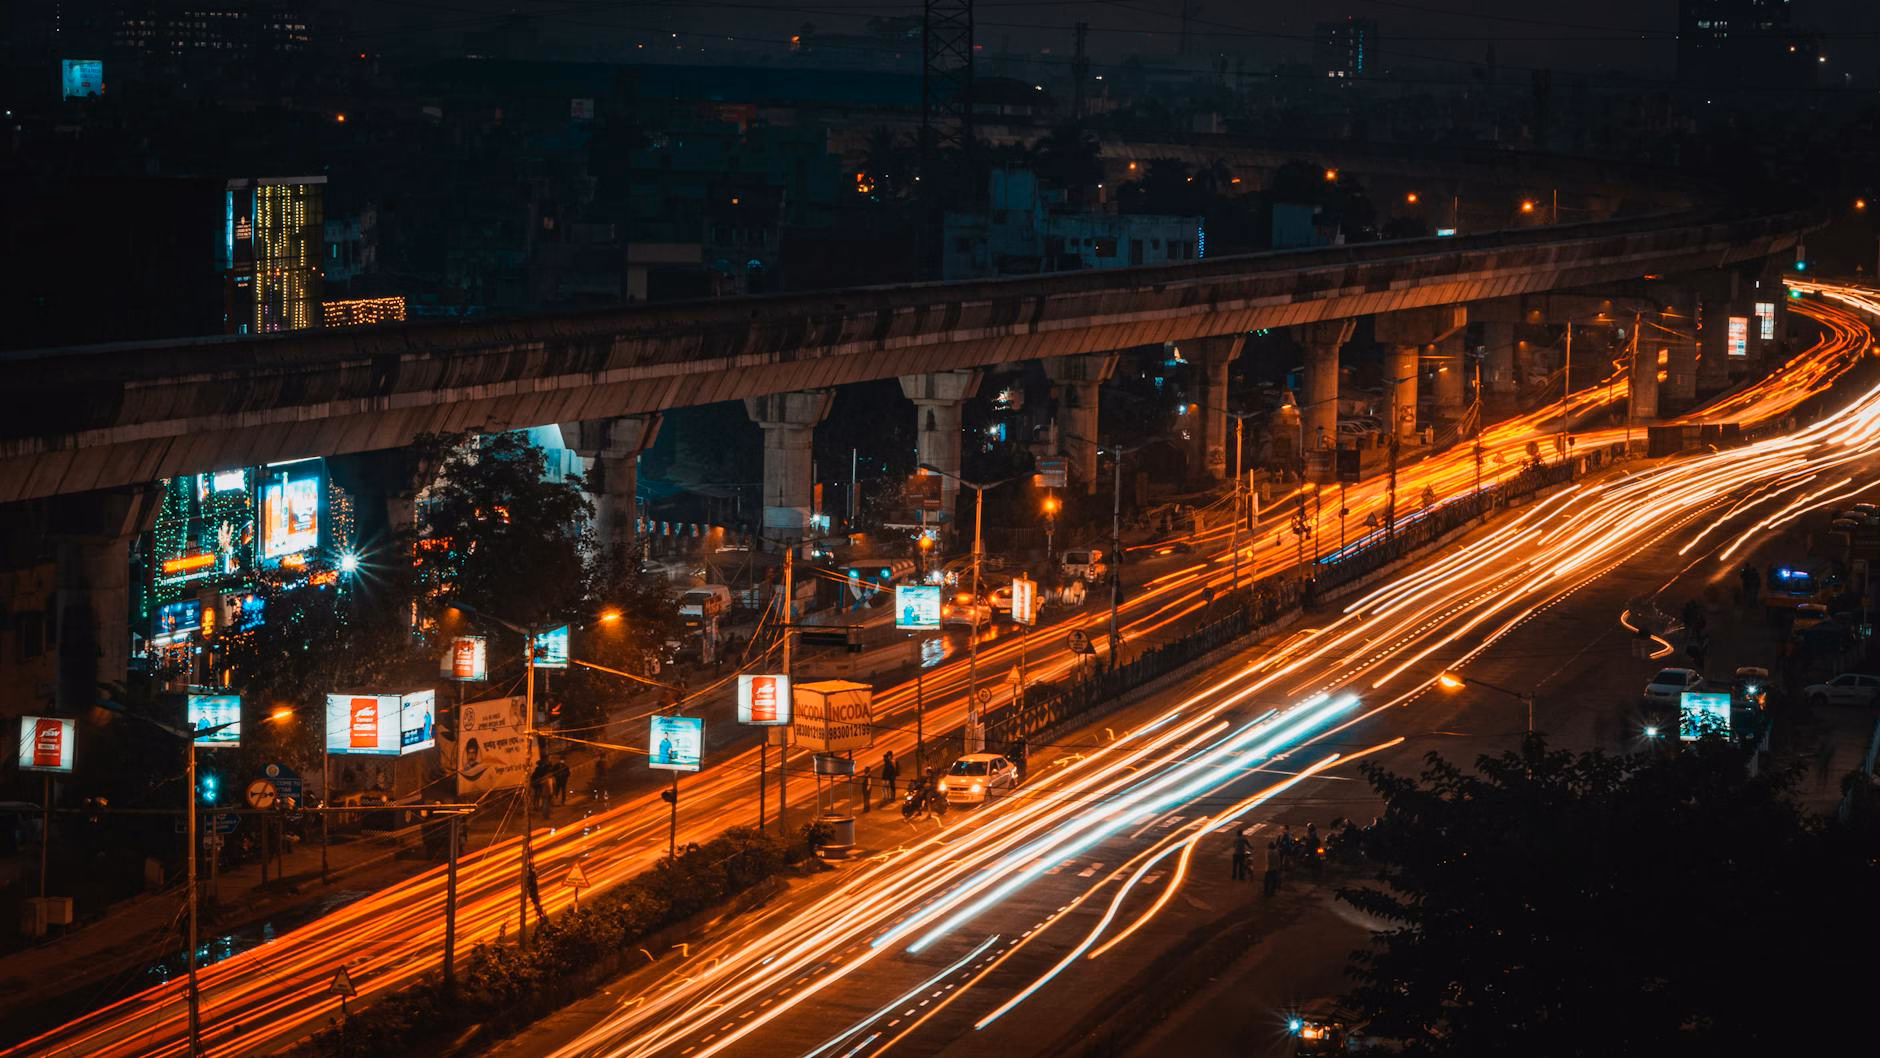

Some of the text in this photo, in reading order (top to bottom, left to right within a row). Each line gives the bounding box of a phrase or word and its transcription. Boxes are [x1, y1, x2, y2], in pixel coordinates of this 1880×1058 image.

[795, 700, 824, 722] INCODA
[828, 702, 870, 722] INCODA
[828, 723, 871, 740] 9830012199
